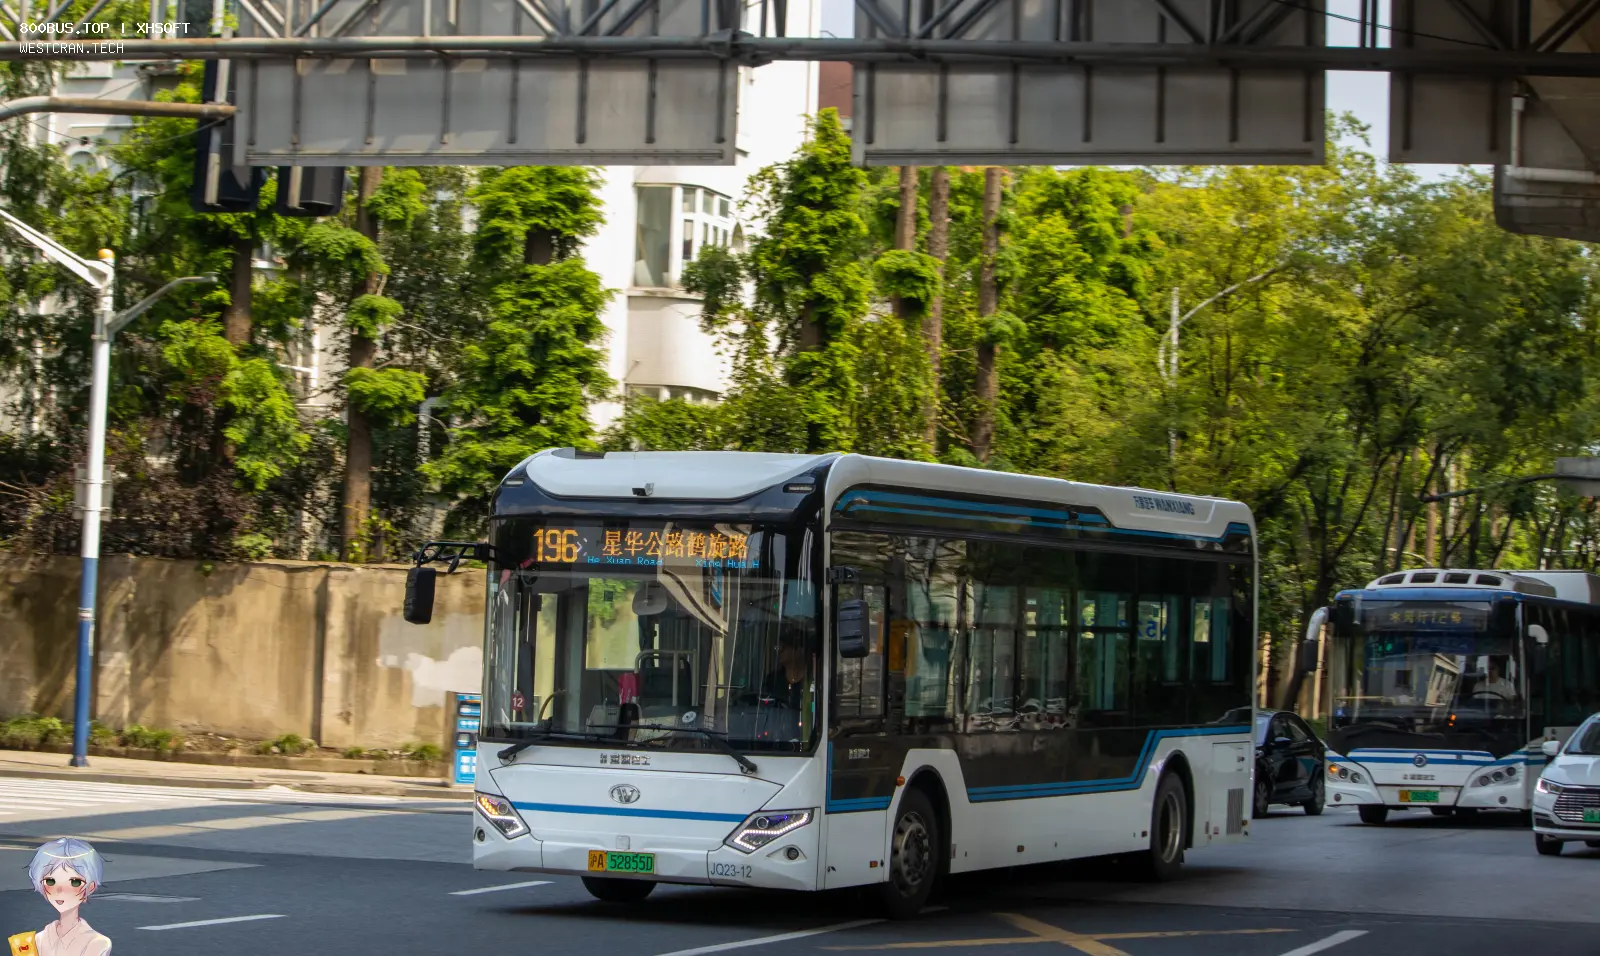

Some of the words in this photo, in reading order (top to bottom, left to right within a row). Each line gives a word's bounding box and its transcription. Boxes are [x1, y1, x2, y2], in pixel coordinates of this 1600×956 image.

[533, 528, 579, 563] 196
[602, 530, 749, 559] 星华公路鹤旋路
[606, 556, 632, 565] Xuan
[637, 556, 663, 566] Road
[512, 697, 523, 708] 12
[710, 862, 753, 879] JQ23-12
